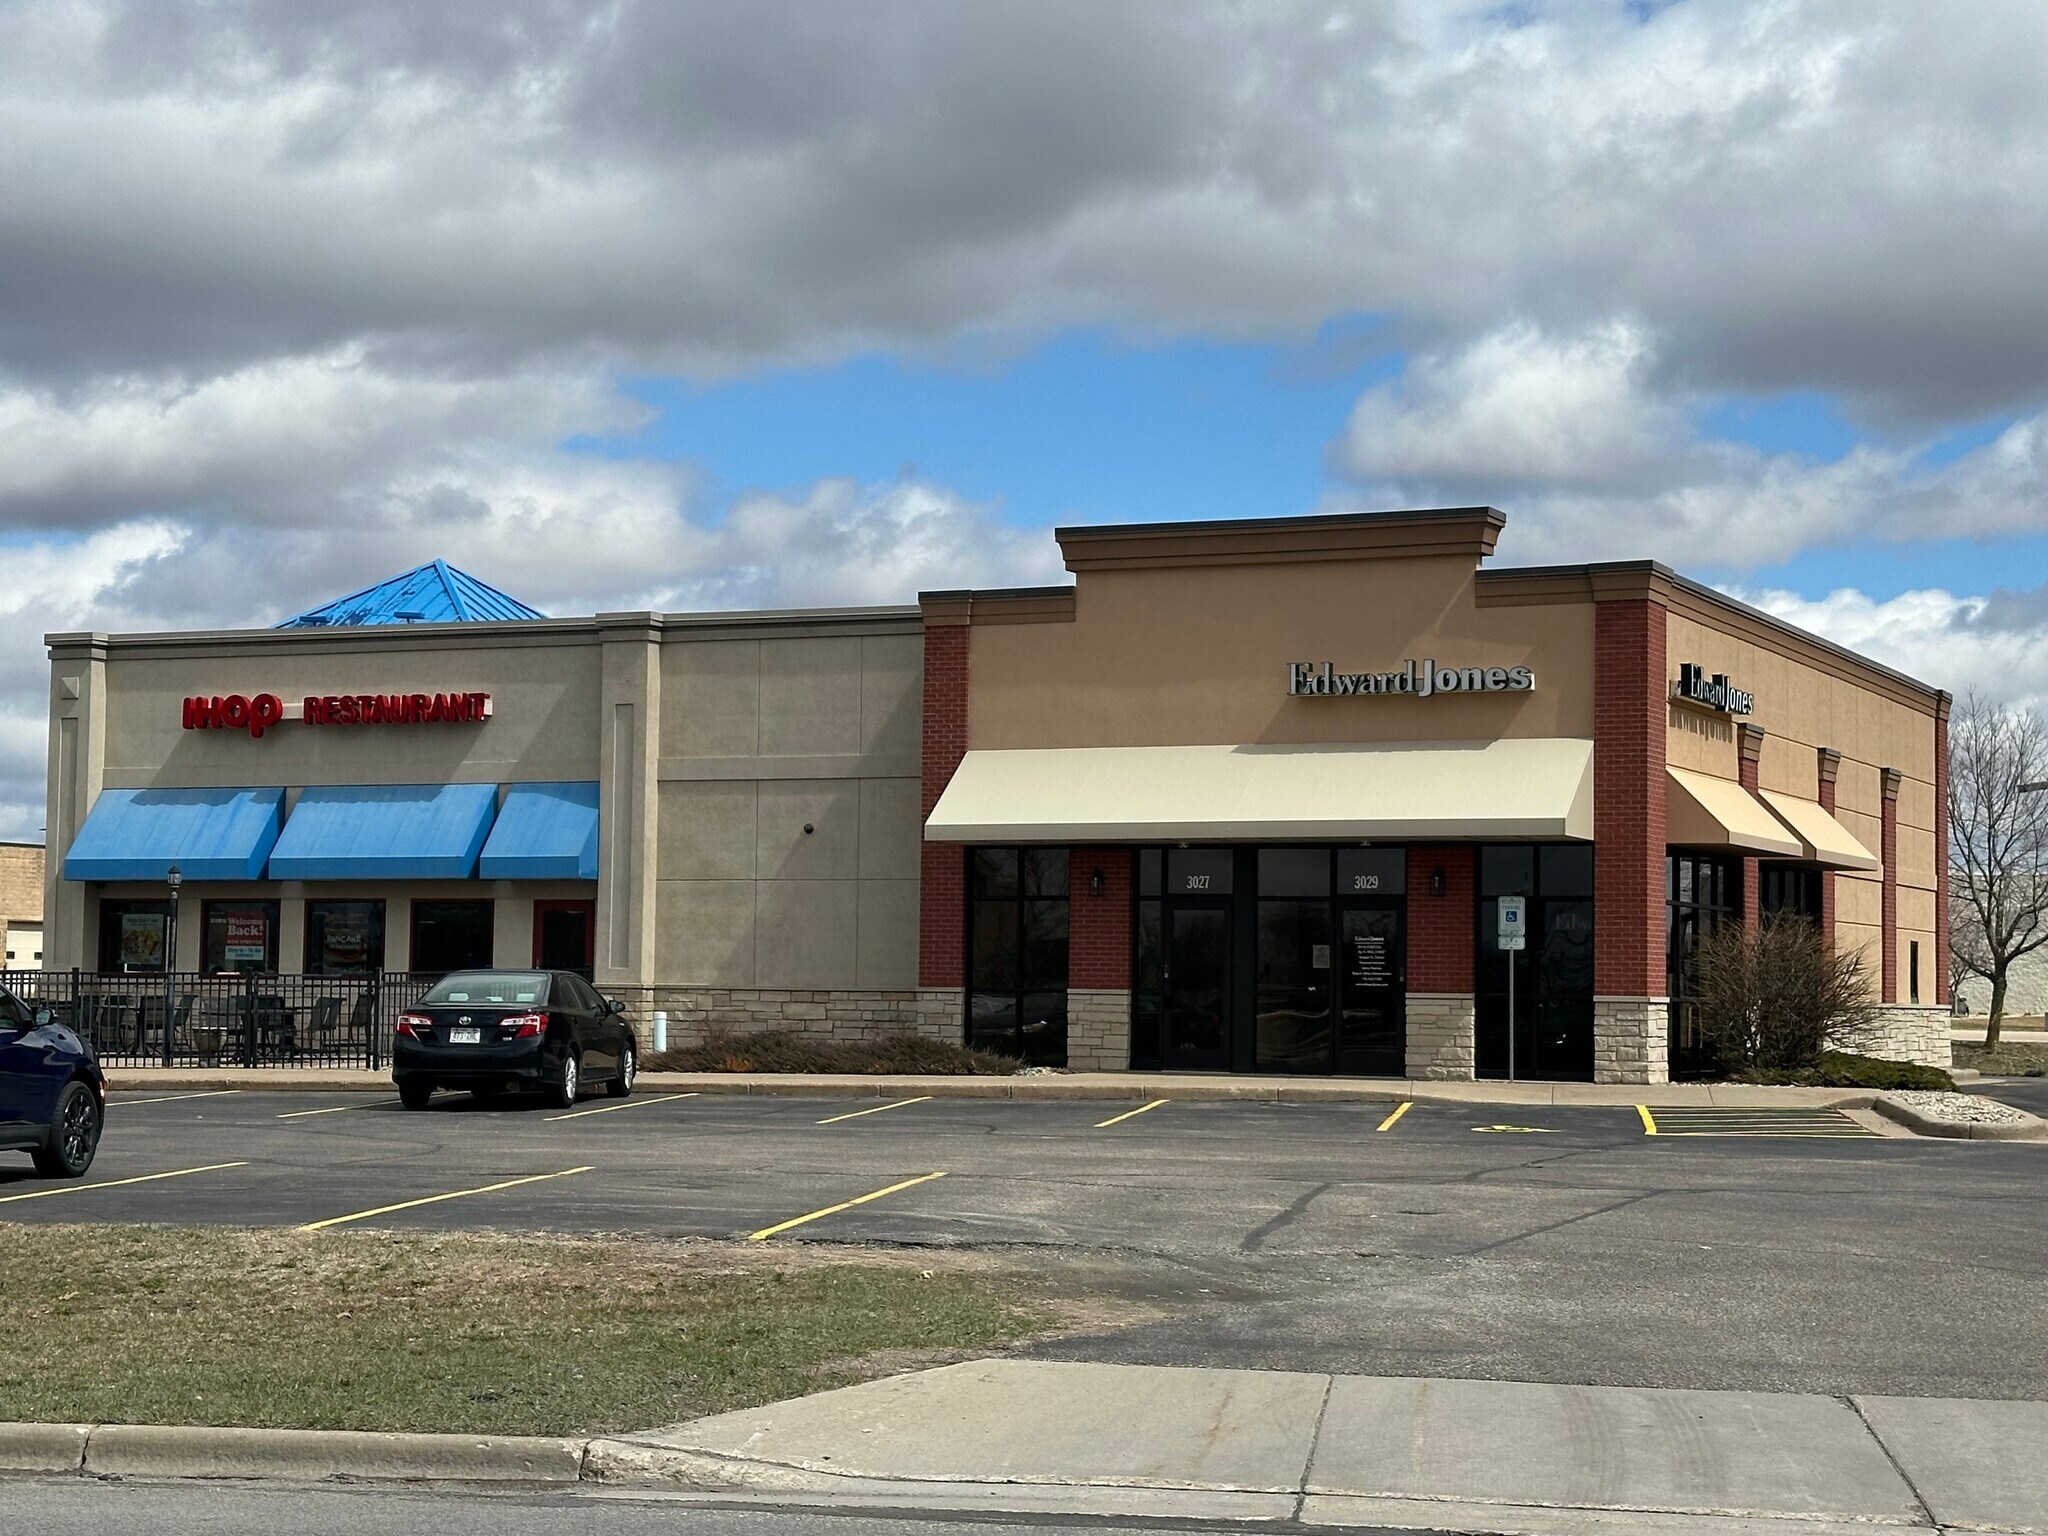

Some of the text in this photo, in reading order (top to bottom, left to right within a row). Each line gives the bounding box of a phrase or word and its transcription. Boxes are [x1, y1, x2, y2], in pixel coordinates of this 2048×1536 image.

[182, 692, 490, 738] IHOP RESTAURANT
[1186, 873, 1210, 889] 3027
[1353, 873, 1379, 889] 3029
[227, 917, 264, 926] Welcome
[227, 925, 264, 936] Back!
[326, 934, 362, 944] PANCAKE
